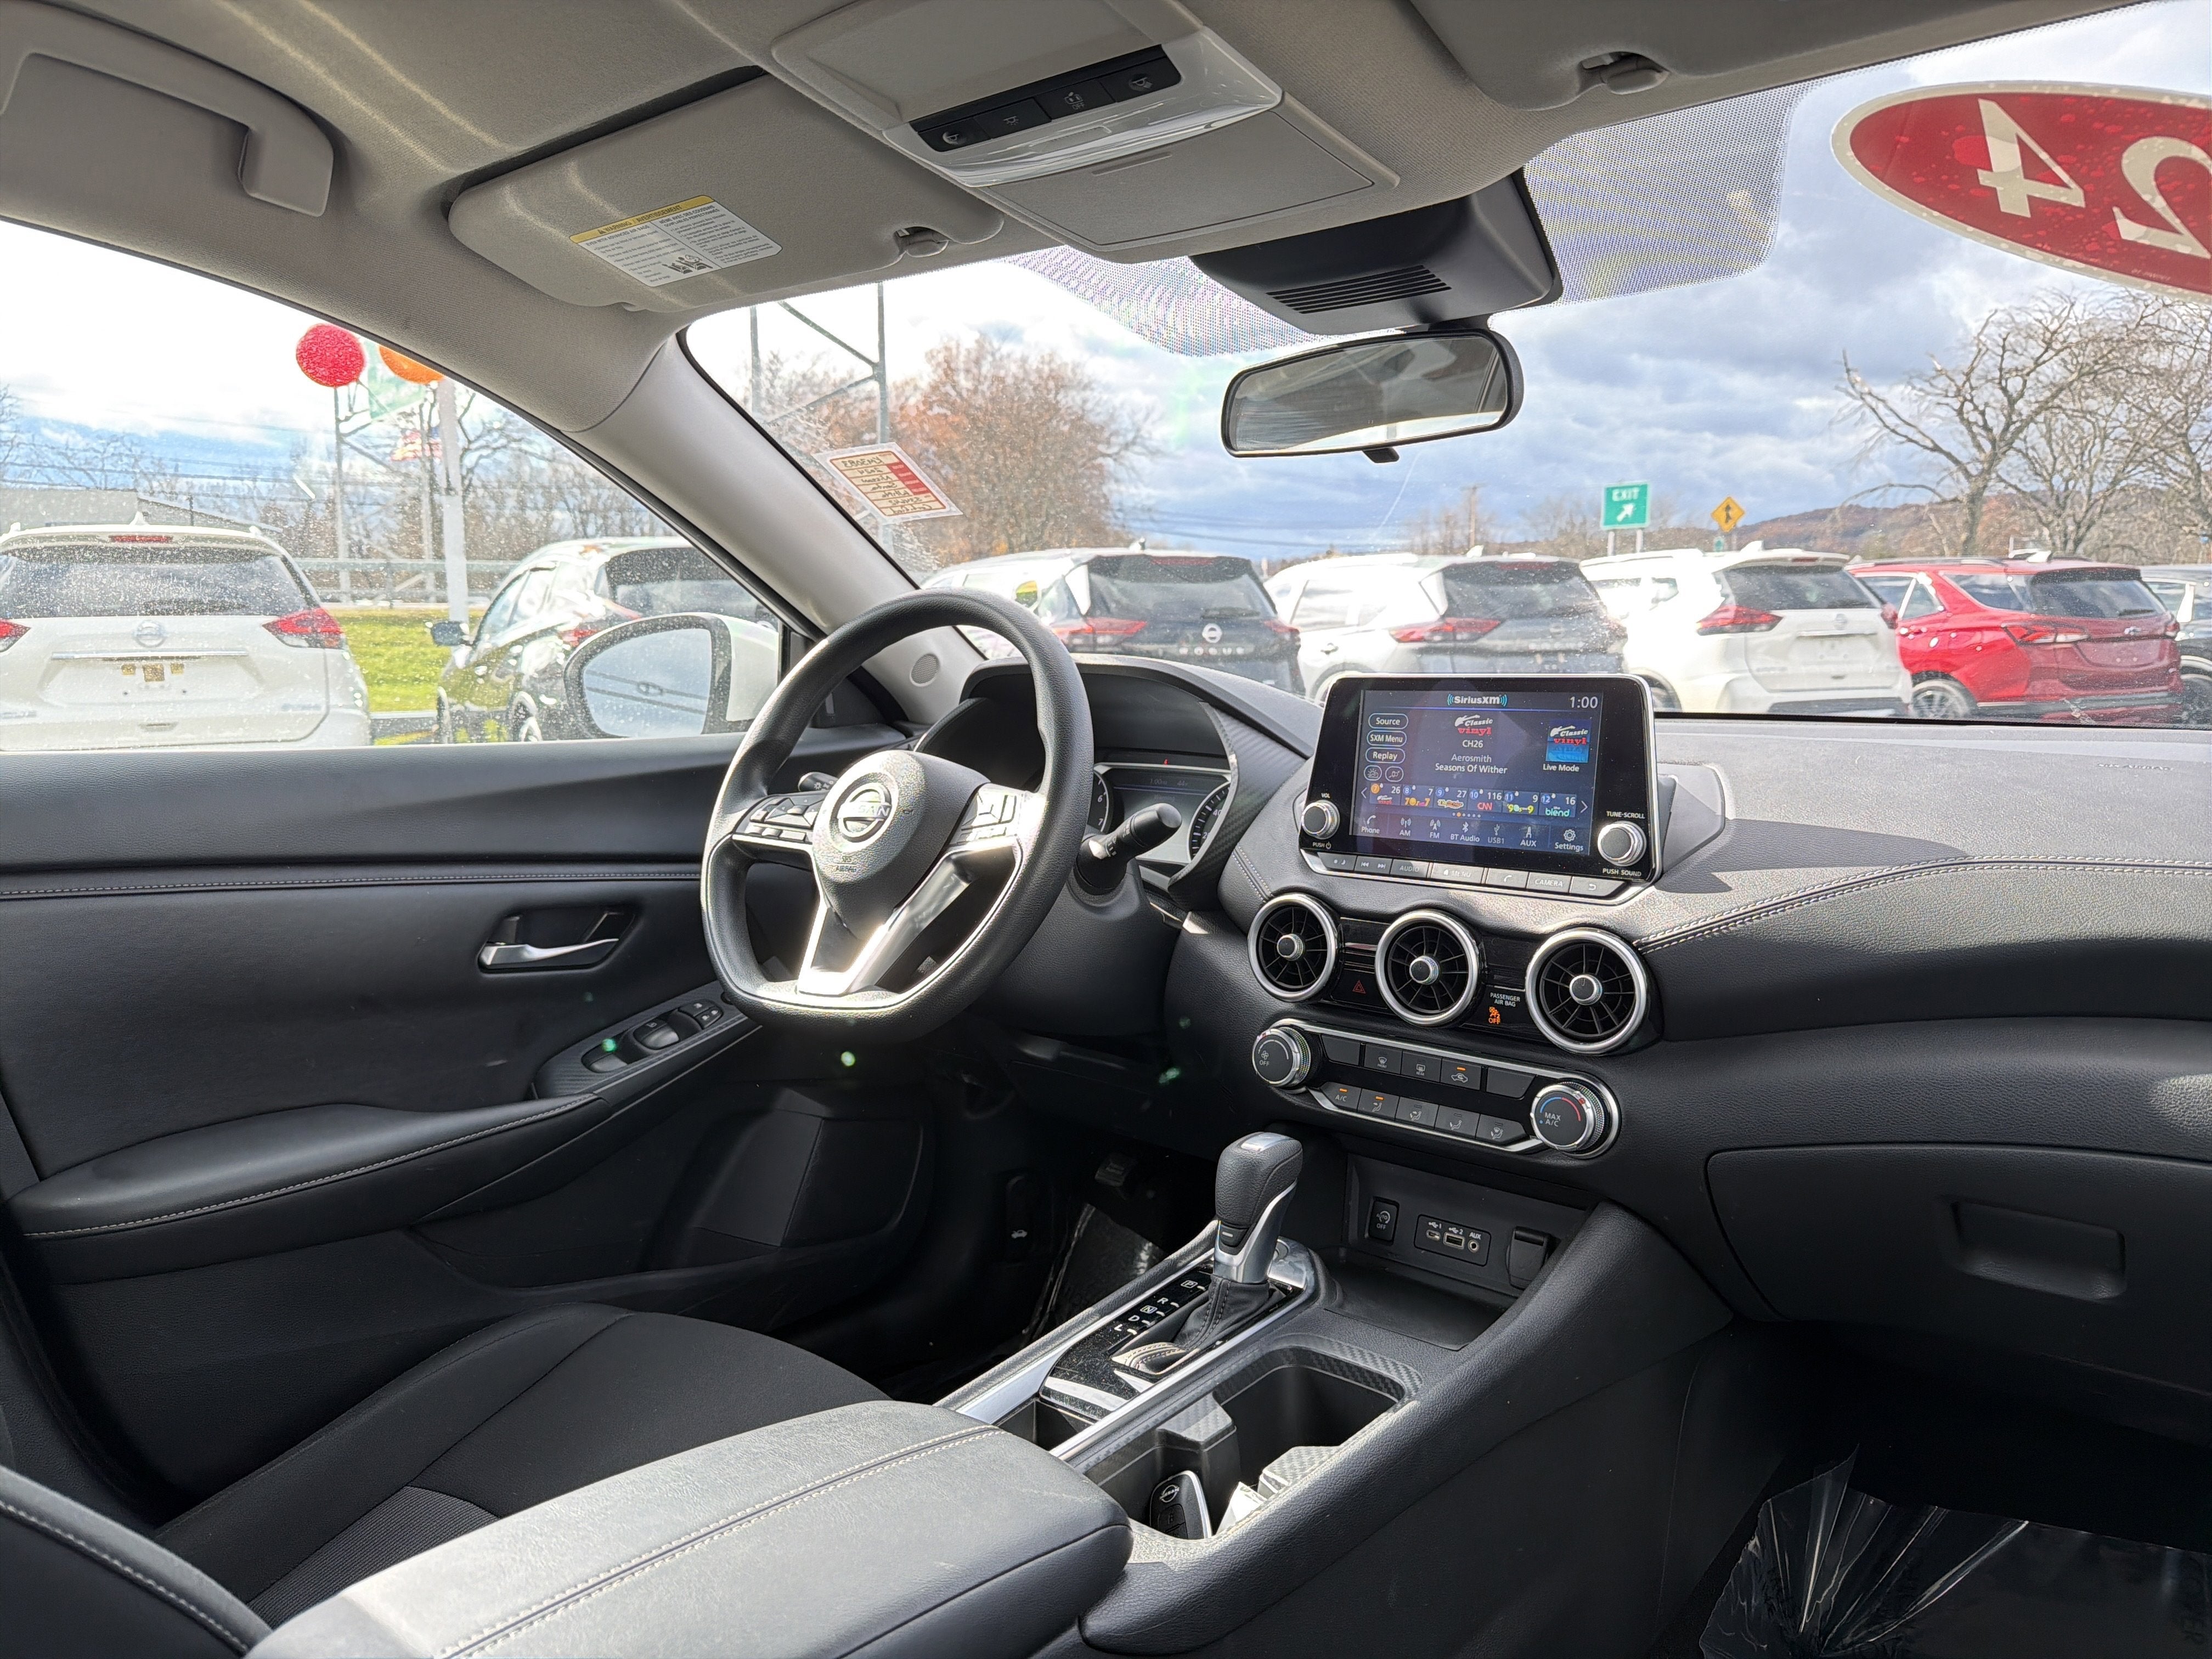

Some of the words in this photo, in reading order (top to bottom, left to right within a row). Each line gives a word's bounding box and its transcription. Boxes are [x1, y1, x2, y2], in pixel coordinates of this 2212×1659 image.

[605, 222, 631, 233] WARNING
[636, 205, 682, 223] AVERTISSEMENT
[1570, 696, 1598, 708] 1:00
[1465, 718, 1493, 726] Classic
[1560, 729, 1589, 737] Classic
[1370, 734, 1384, 742] SXM
[1385, 735, 1403, 743] Menu
[1462, 740, 1483, 748] CH26
[1373, 752, 1398, 761] Replay
[1451, 754, 1492, 763] Aerosmith
[1435, 763, 1465, 772] Seasons
[1467, 764, 1477, 772] Of
[1478, 765, 1508, 774] Wither
[1391, 786, 1401, 794] 26
[1457, 790, 1467, 798] 27
[1487, 792, 1502, 800] 116
[1533, 795, 1538, 803] 9
[1565, 797, 1576, 805] 16
[1477, 802, 1492, 811] CNN
[1527, 805, 1534, 814] 9
[1545, 808, 1570, 817] blend
[1555, 842, 1584, 852] Settings
[1535, 879, 1563, 887] CAMERA
[1490, 992, 1520, 1002] PASSENGER
[1544, 1111, 1561, 1121] MAX
[1545, 1119, 1559, 1127] A/C
[1376, 1212, 1388, 1221] AUTO
[1469, 1232, 1482, 1240] AUX
